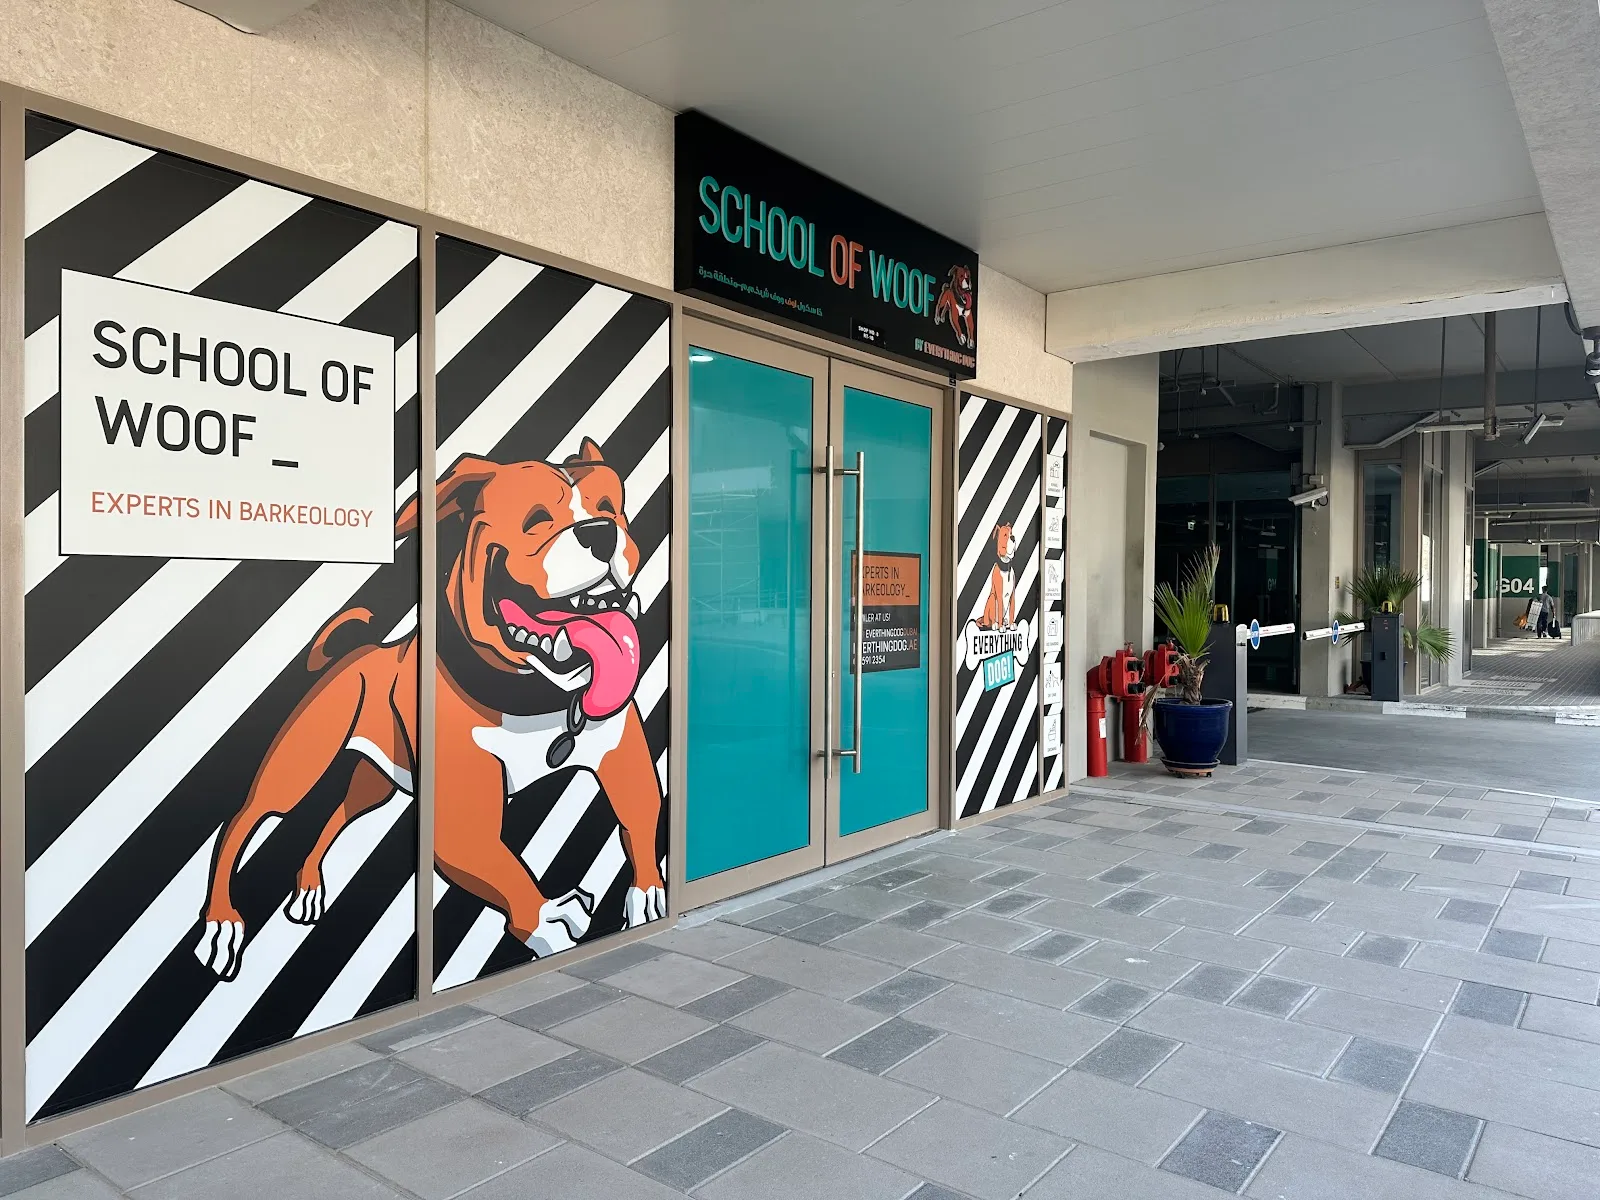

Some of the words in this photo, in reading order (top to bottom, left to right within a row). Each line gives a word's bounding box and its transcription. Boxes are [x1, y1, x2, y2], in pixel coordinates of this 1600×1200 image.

[699, 175, 825, 278] SCHOOL
[830, 234, 864, 289] OF
[868, 249, 936, 317] WOOF
[92, 320, 307, 397] SCHOOL
[321, 360, 374, 405] OF
[914, 338, 924, 351] BY
[924, 341, 963, 364] EVERYTHING
[95, 395, 256, 457] WOOF
[91, 492, 200, 518] EXPERTS
[209, 500, 231, 520] IN
[240, 502, 373, 528] BARKEOLOGY
[891, 567, 900, 579] IN
[1496, 577, 1535, 594] G04
[853, 639, 918, 654] ERTHINGDOG.AE
[973, 632, 1023, 655] EVERYTHING
[987, 658, 1012, 686] DOG!
